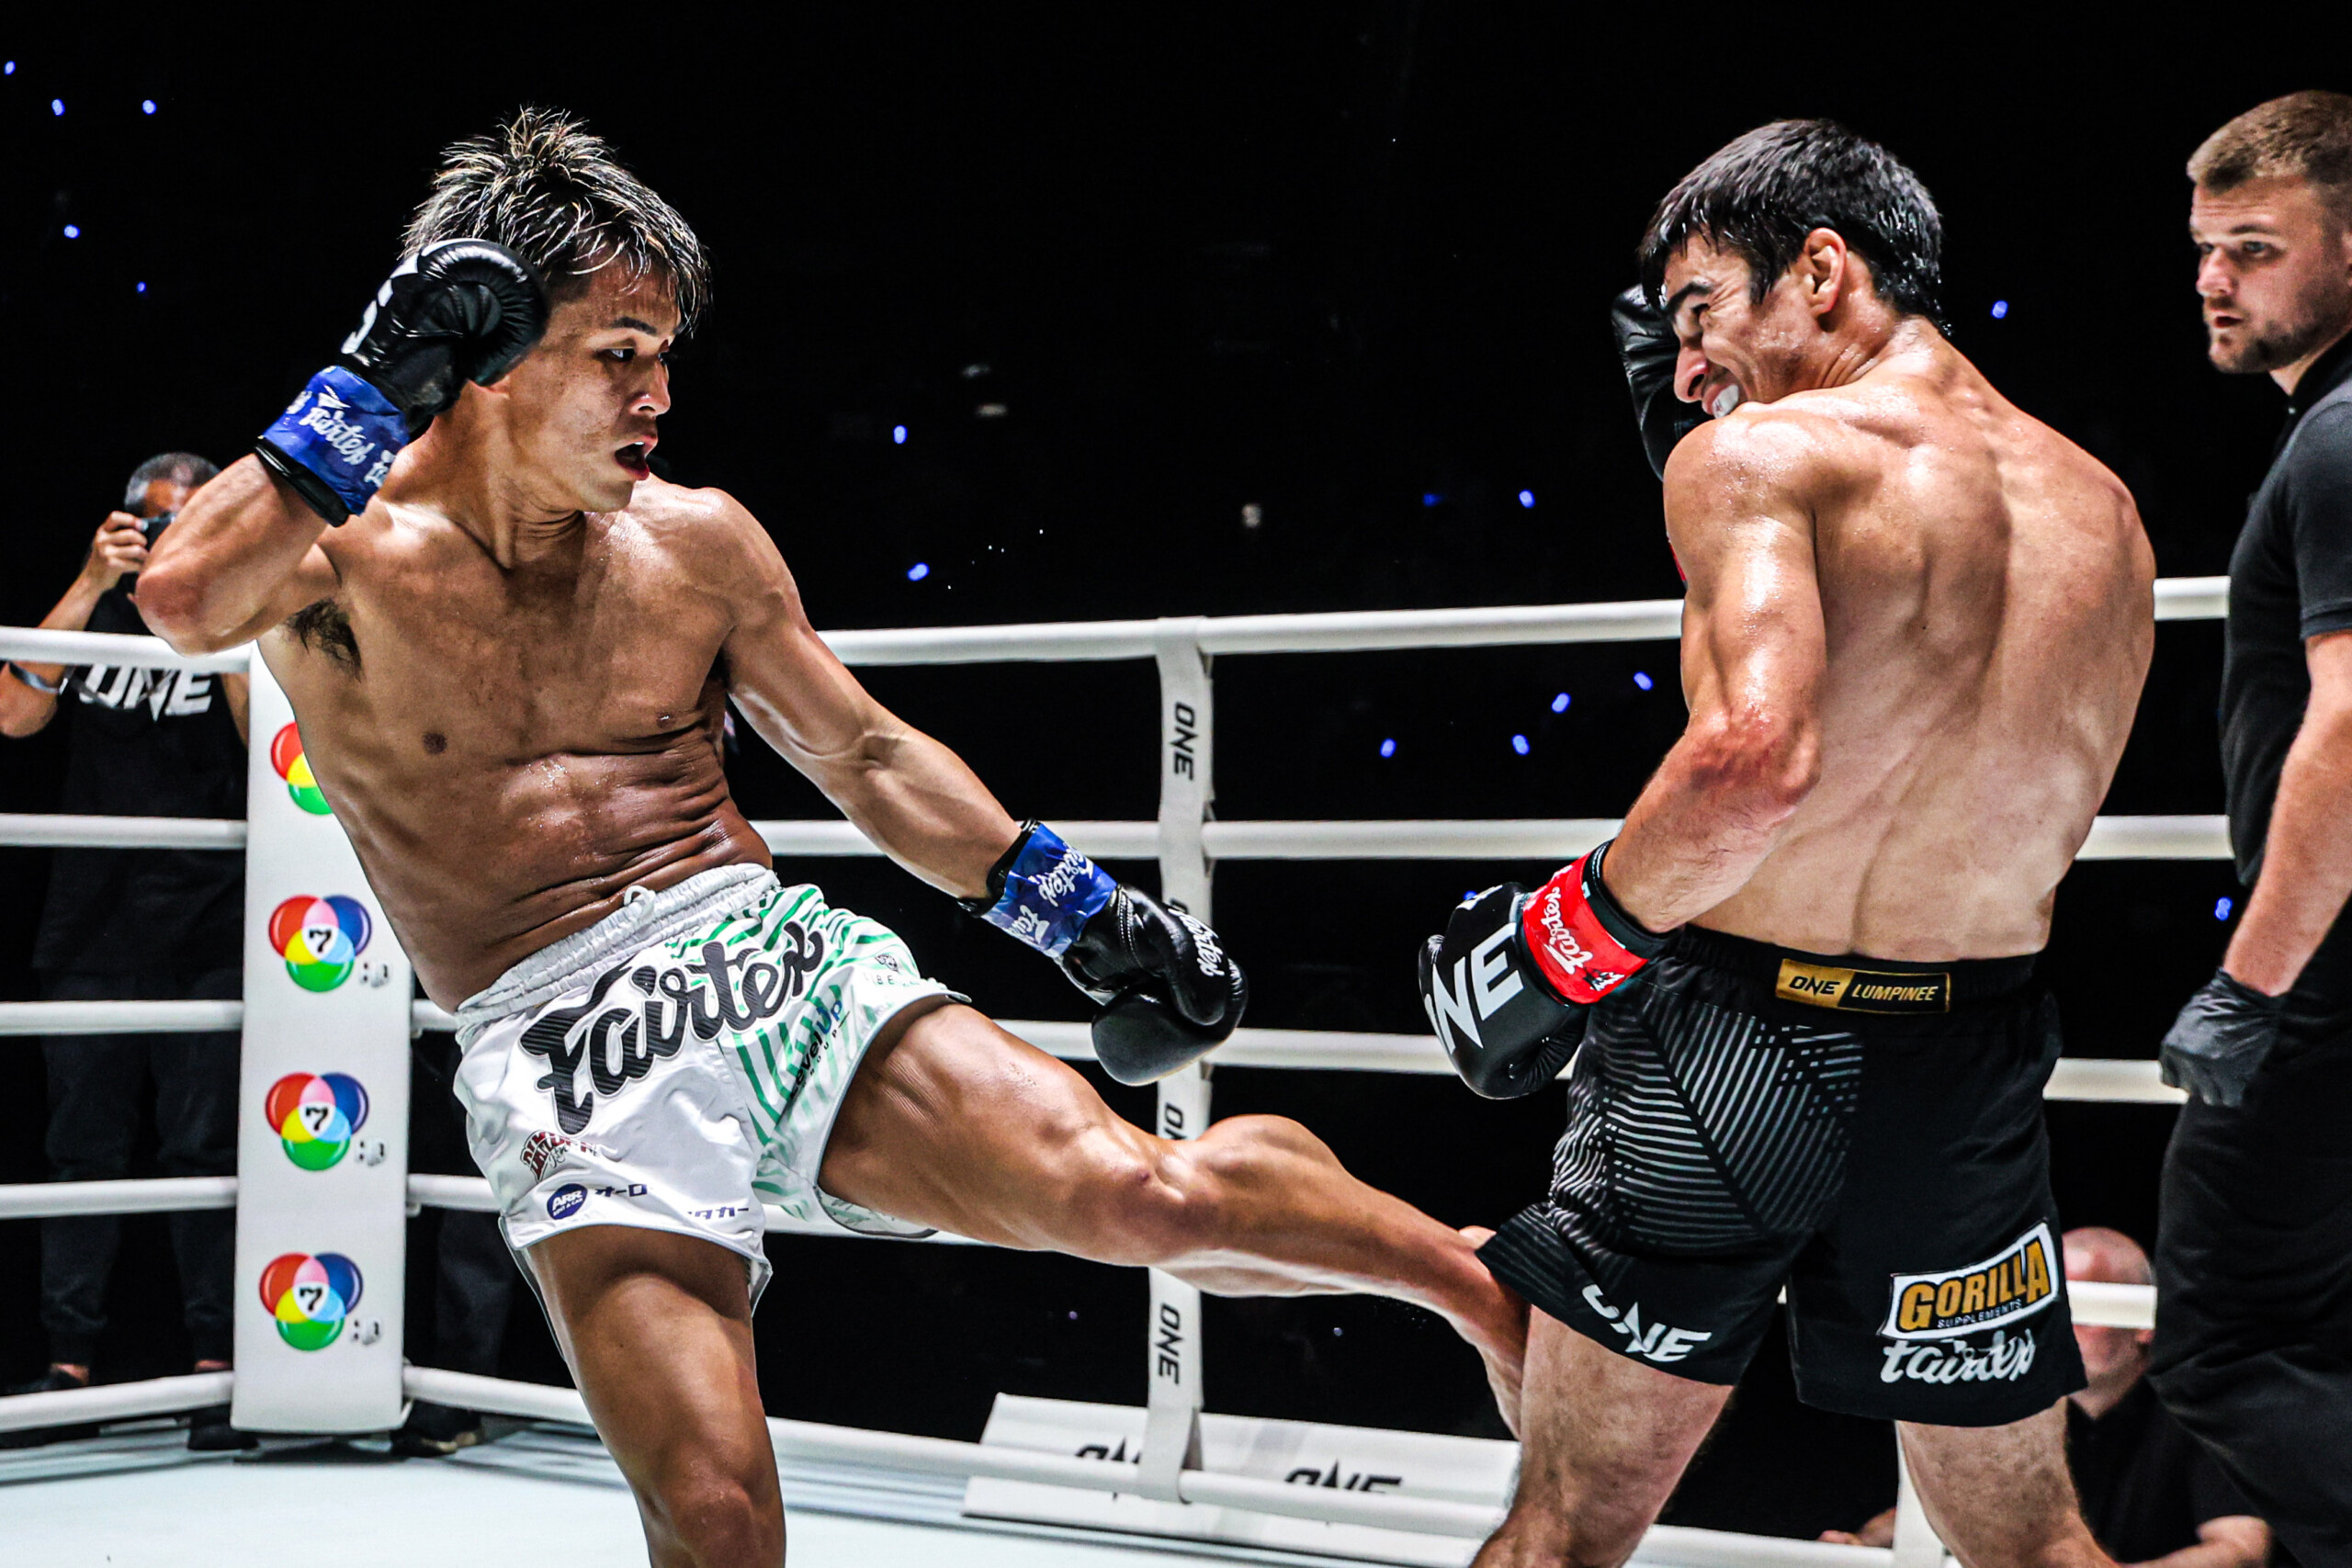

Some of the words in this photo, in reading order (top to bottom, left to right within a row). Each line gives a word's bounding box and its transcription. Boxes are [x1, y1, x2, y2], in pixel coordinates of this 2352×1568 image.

[1170, 701, 1198, 781] ONE
[309, 929, 332, 953] 7
[1425, 922, 1524, 1055] NE
[1789, 976, 1840, 996] ONE
[1851, 984, 1939, 1001] LUMPINEE
[520, 921, 824, 1134] Fairtex
[305, 1106, 329, 1131] 7
[300, 1287, 322, 1312] 7
[1898, 1240, 2051, 1331] GORILLA
[1937, 1298, 2022, 1328] SUPPLEMENTS
[1154, 1303, 1184, 1386] ONE
